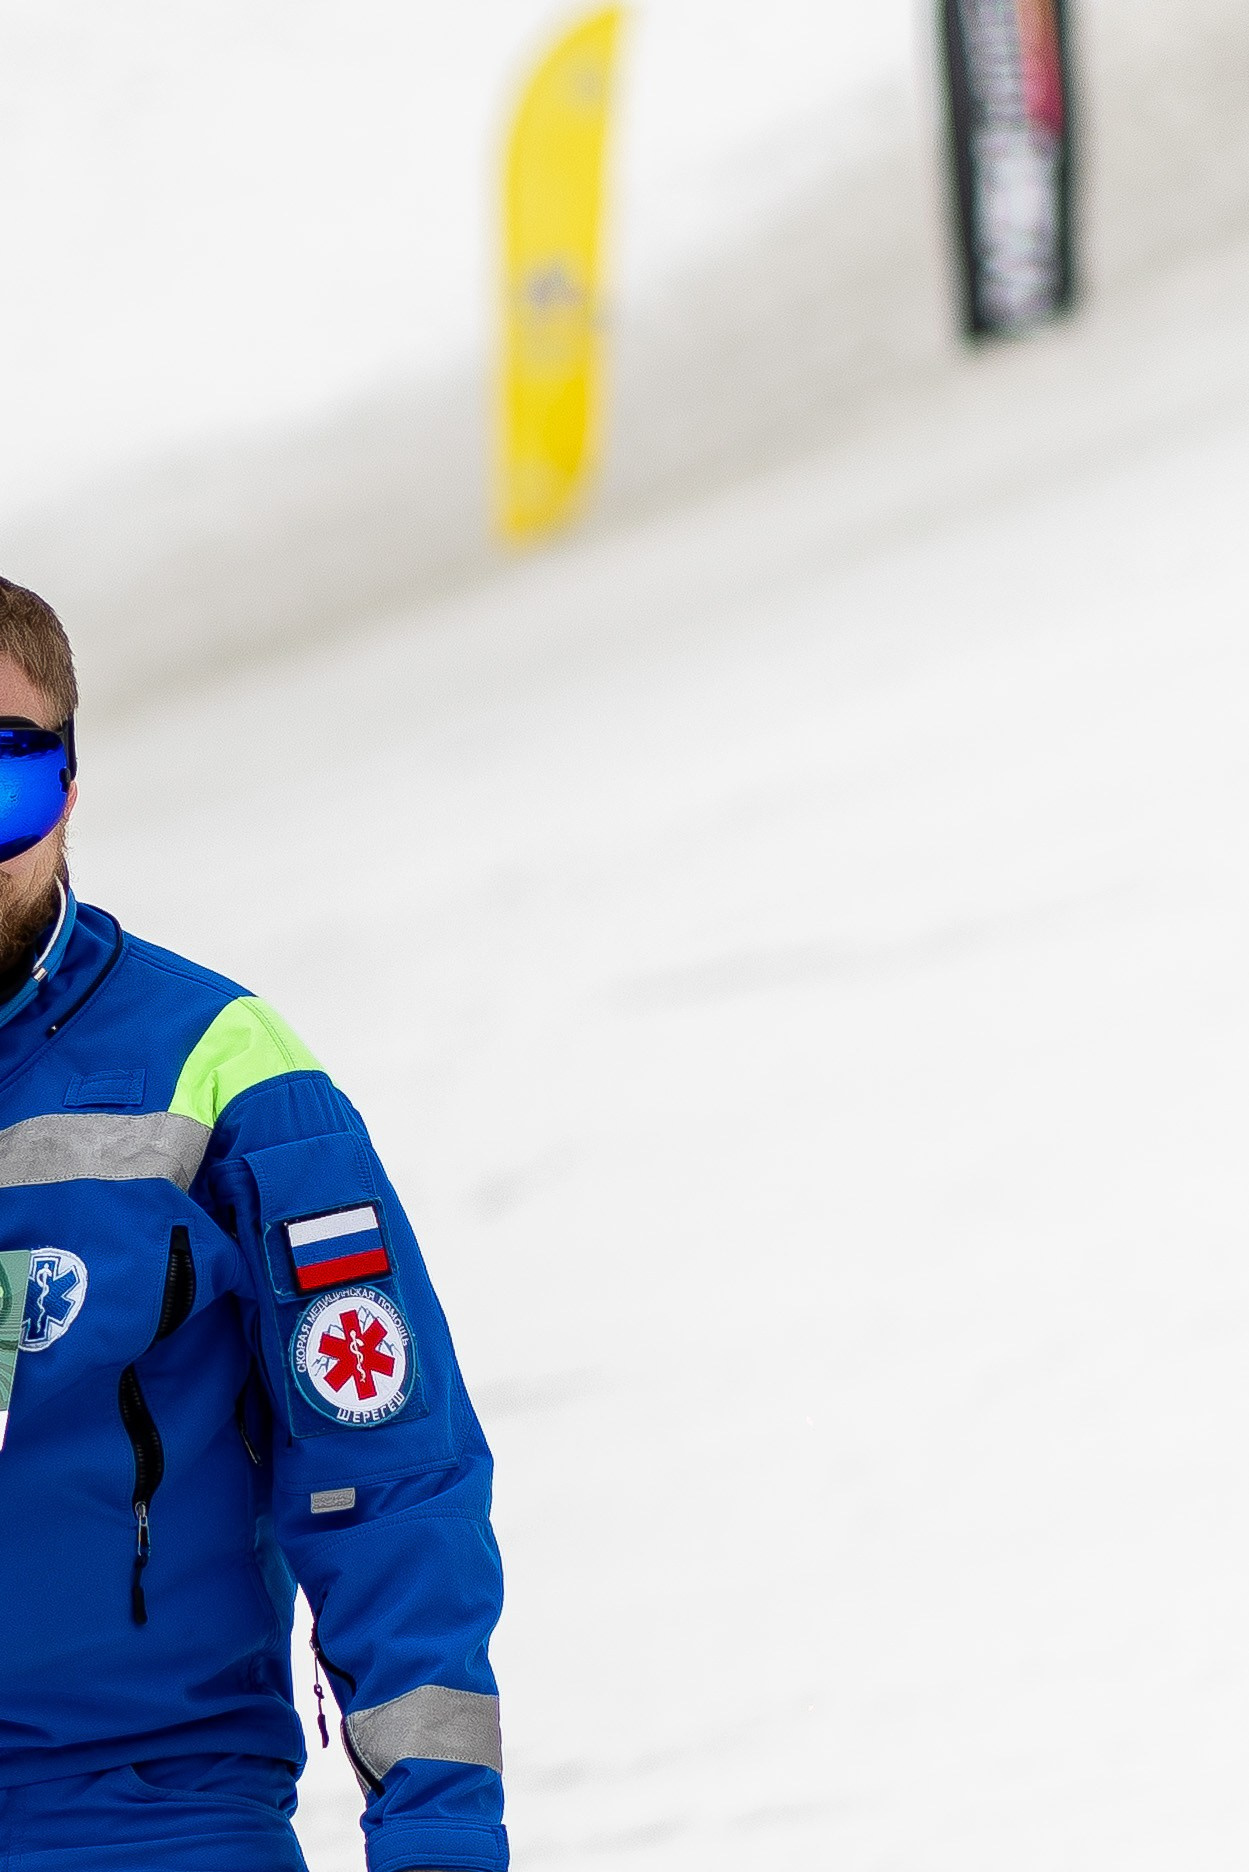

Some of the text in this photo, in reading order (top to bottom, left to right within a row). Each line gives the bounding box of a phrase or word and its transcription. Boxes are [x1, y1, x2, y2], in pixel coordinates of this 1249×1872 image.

[296, 1324, 311, 1373] СКОРАЯ
[378, 1295, 410, 1347] ПОМОЩЬ
[336, 1391, 405, 1423] ШЕРЕГЕШ
